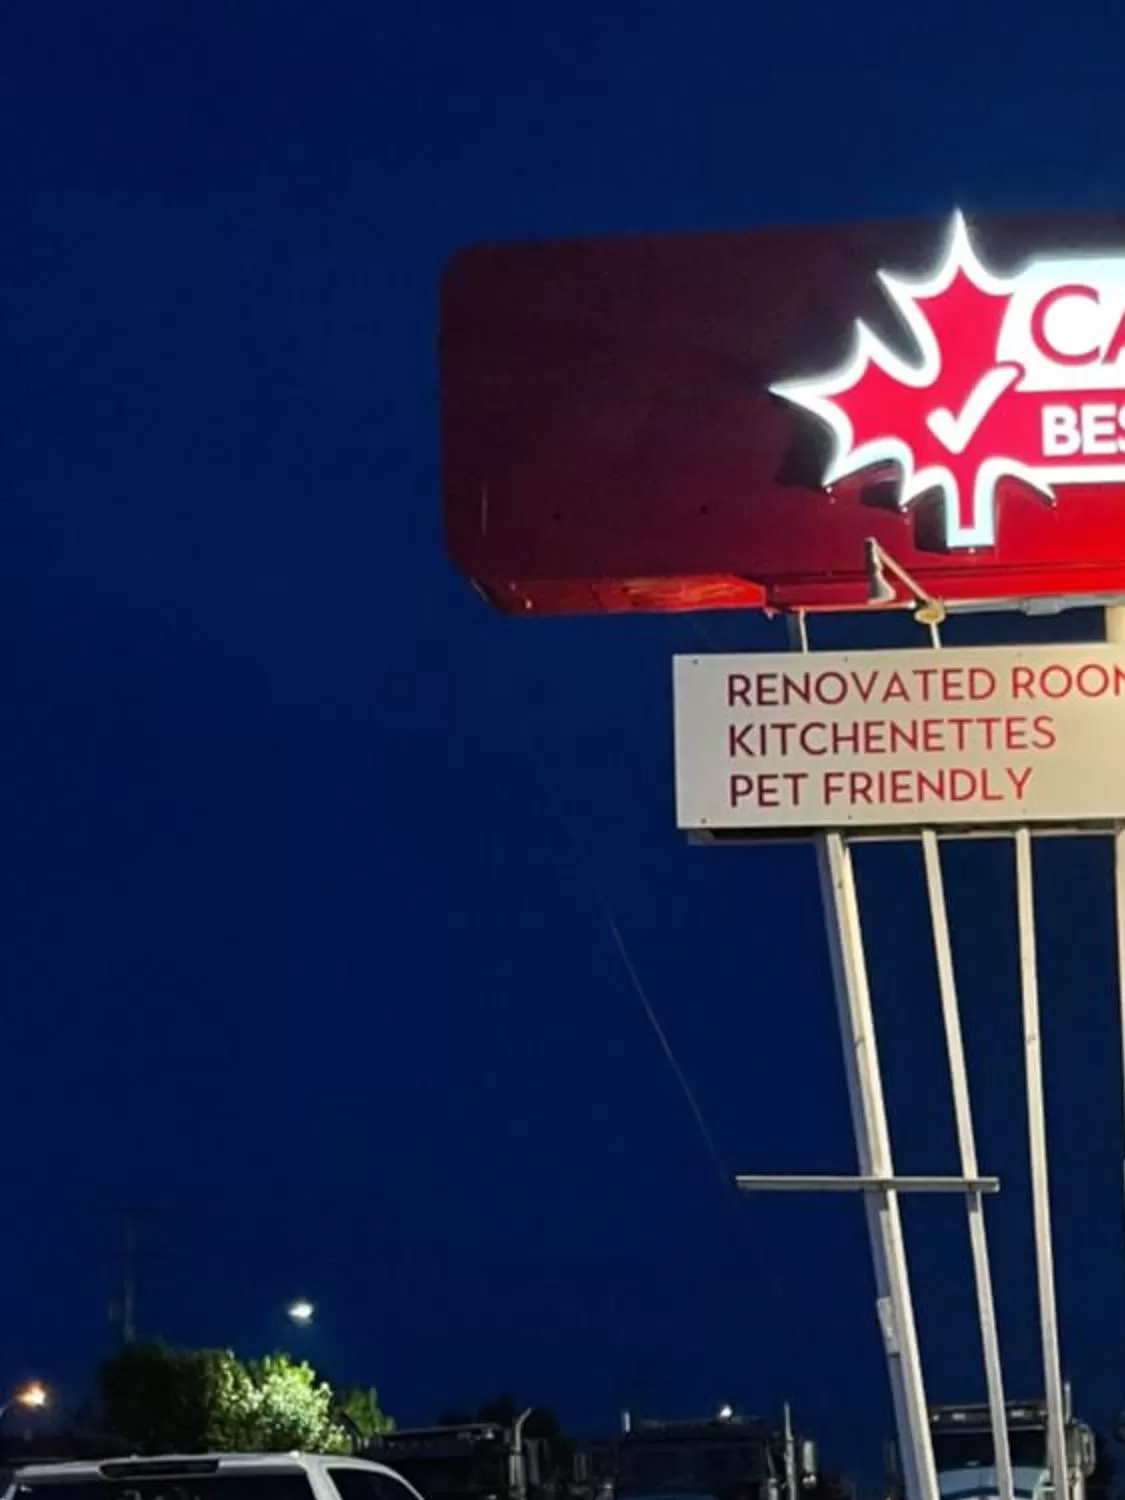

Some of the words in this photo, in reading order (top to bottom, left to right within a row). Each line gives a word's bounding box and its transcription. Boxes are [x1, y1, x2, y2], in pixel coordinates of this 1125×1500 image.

[727, 666, 997, 707] RENOVATED
[729, 714, 1057, 757] KITCHENETTES
[730, 772, 809, 807] PET
[823, 766, 1034, 806] FRIENDLY
